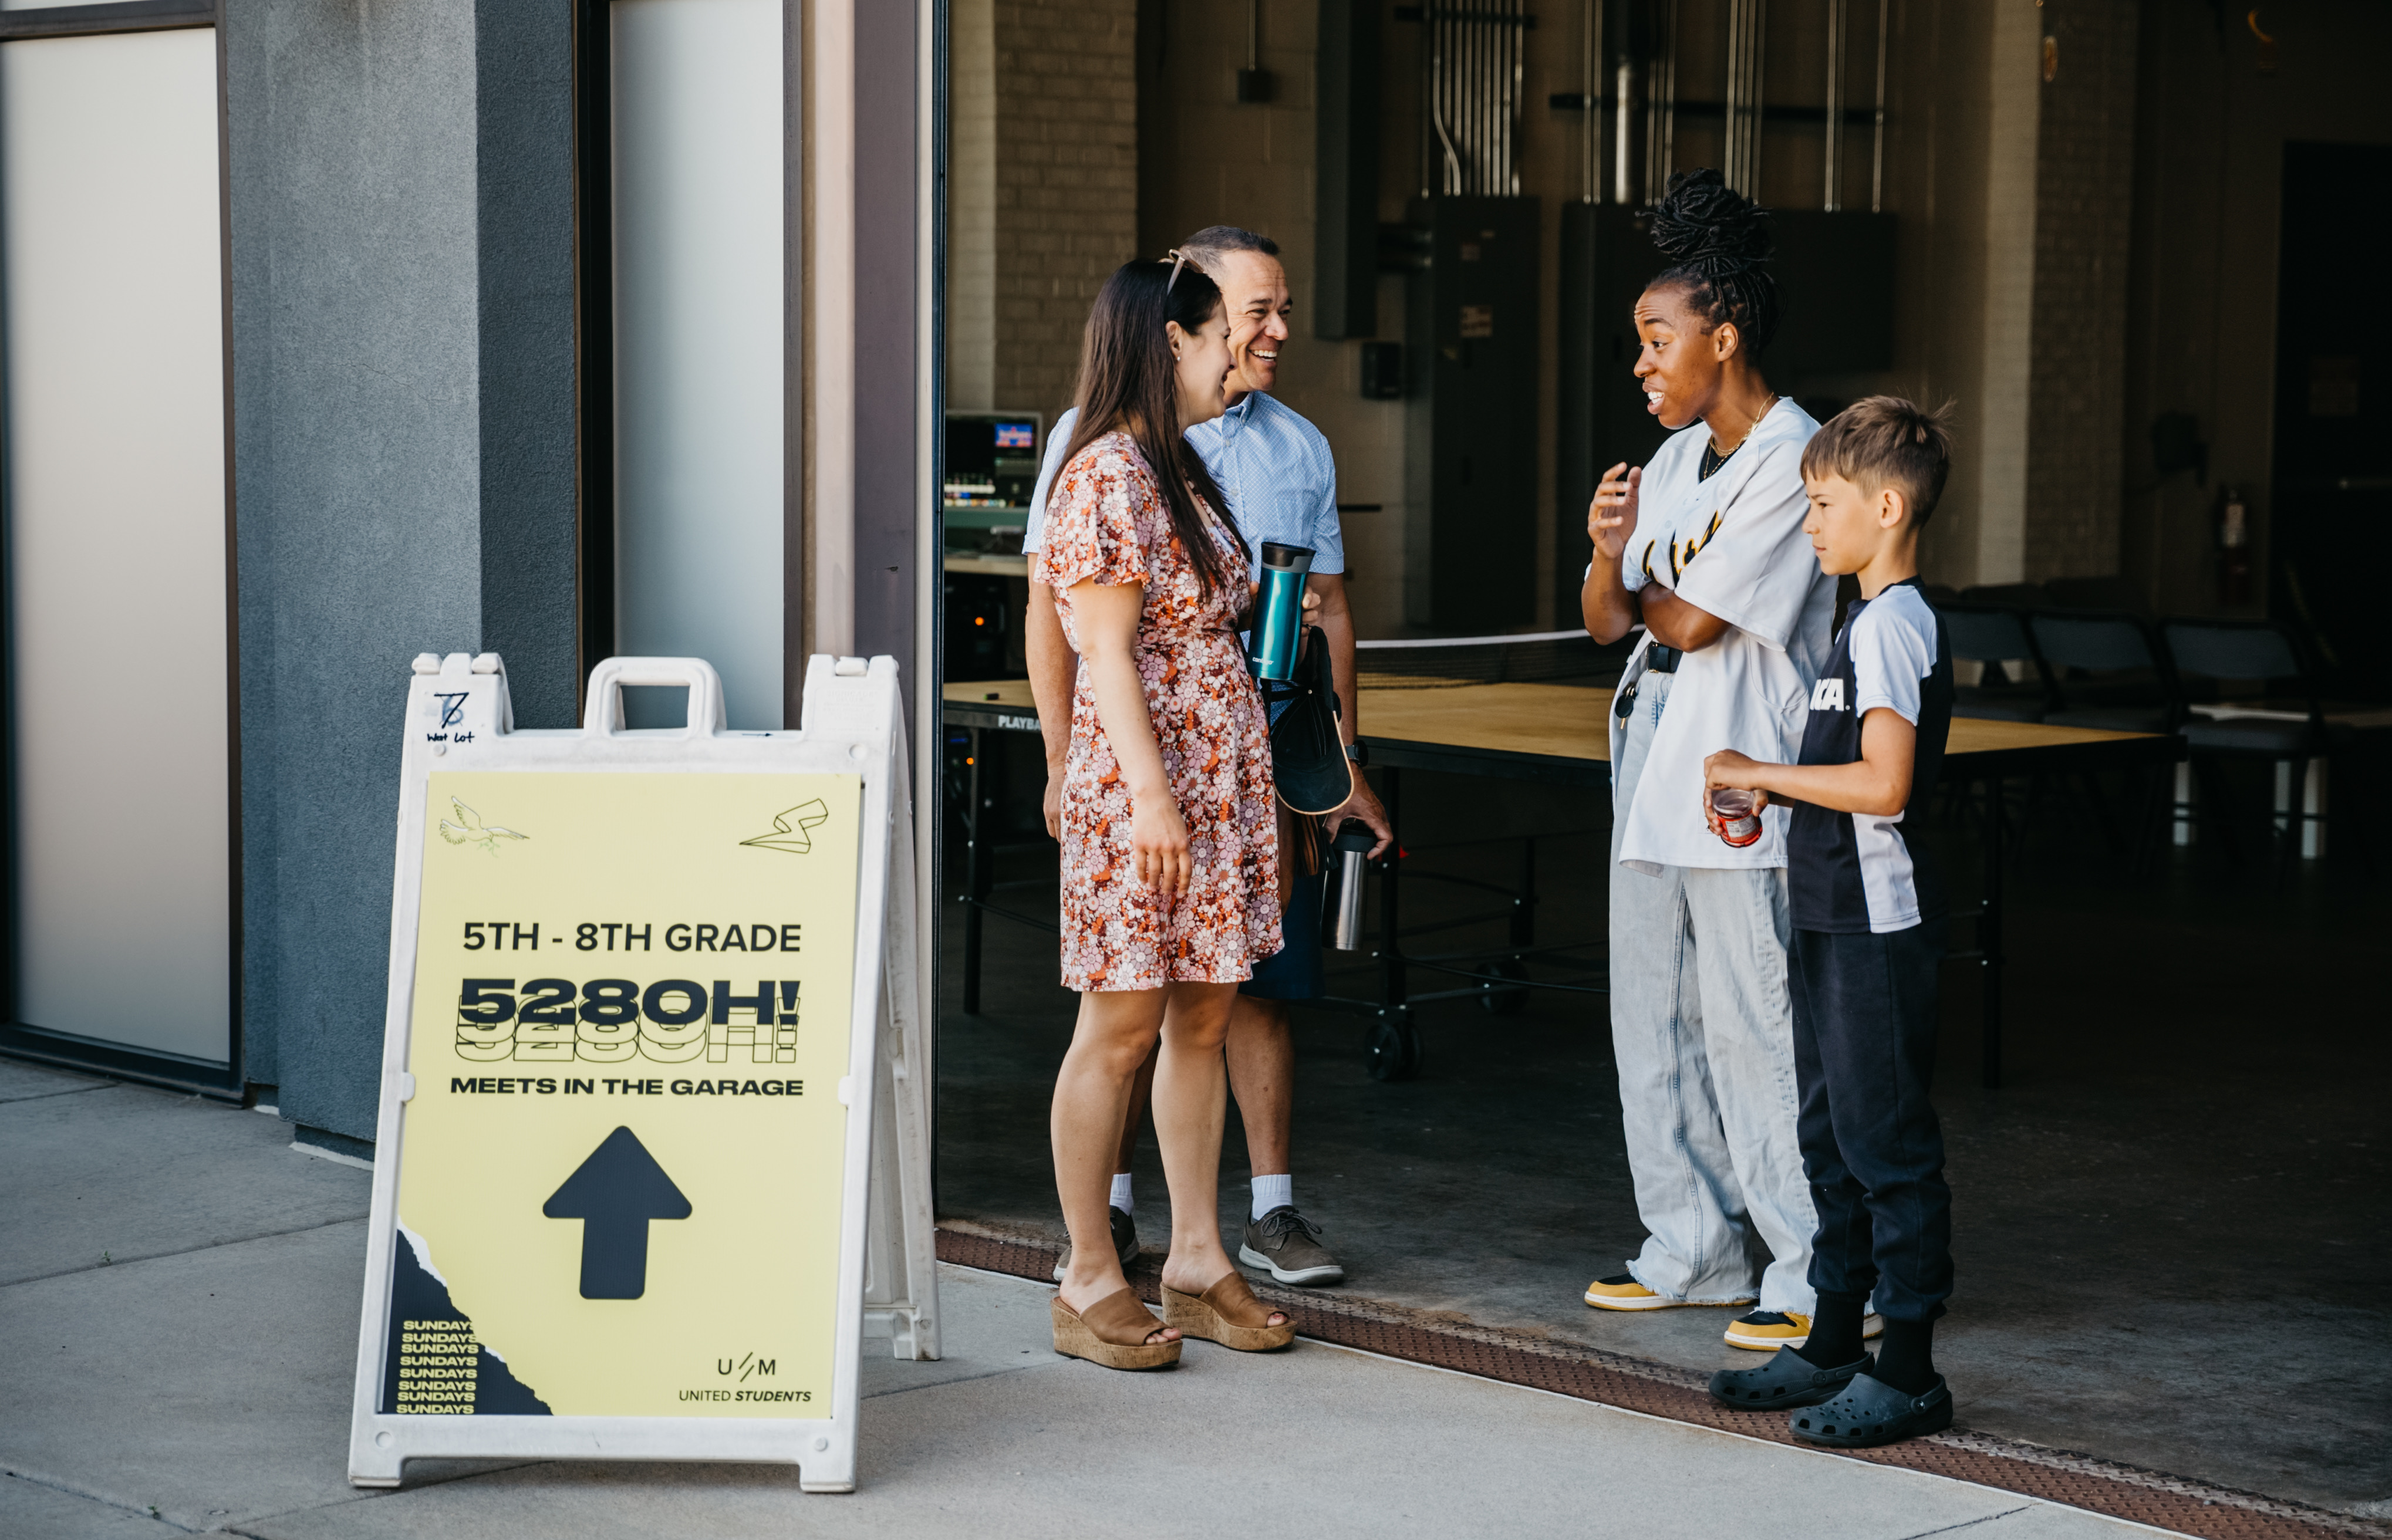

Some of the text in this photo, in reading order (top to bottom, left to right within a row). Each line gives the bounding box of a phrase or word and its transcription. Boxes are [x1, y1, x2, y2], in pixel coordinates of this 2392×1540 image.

[434, 692, 470, 730] 7
[454, 731, 475, 743] Lot
[463, 922, 539, 951] 5TH
[575, 923, 652, 951] 8TH
[665, 923, 801, 952] GRADE
[451, 1078, 804, 1096] MEETS IN THE GARAGE
[402, 1333, 477, 1343] SUNDAYS
[402, 1343, 479, 1354] SUNDAYS
[400, 1356, 478, 1366] SUNDAYS
[400, 1368, 478, 1379] SUNDAYS
[399, 1380, 477, 1391] SUNDAYS
[397, 1392, 475, 1402] SUNDAYS
[679, 1390, 811, 1402] UNITED STUDENTS
[396, 1404, 474, 1414] SUNDAYS
